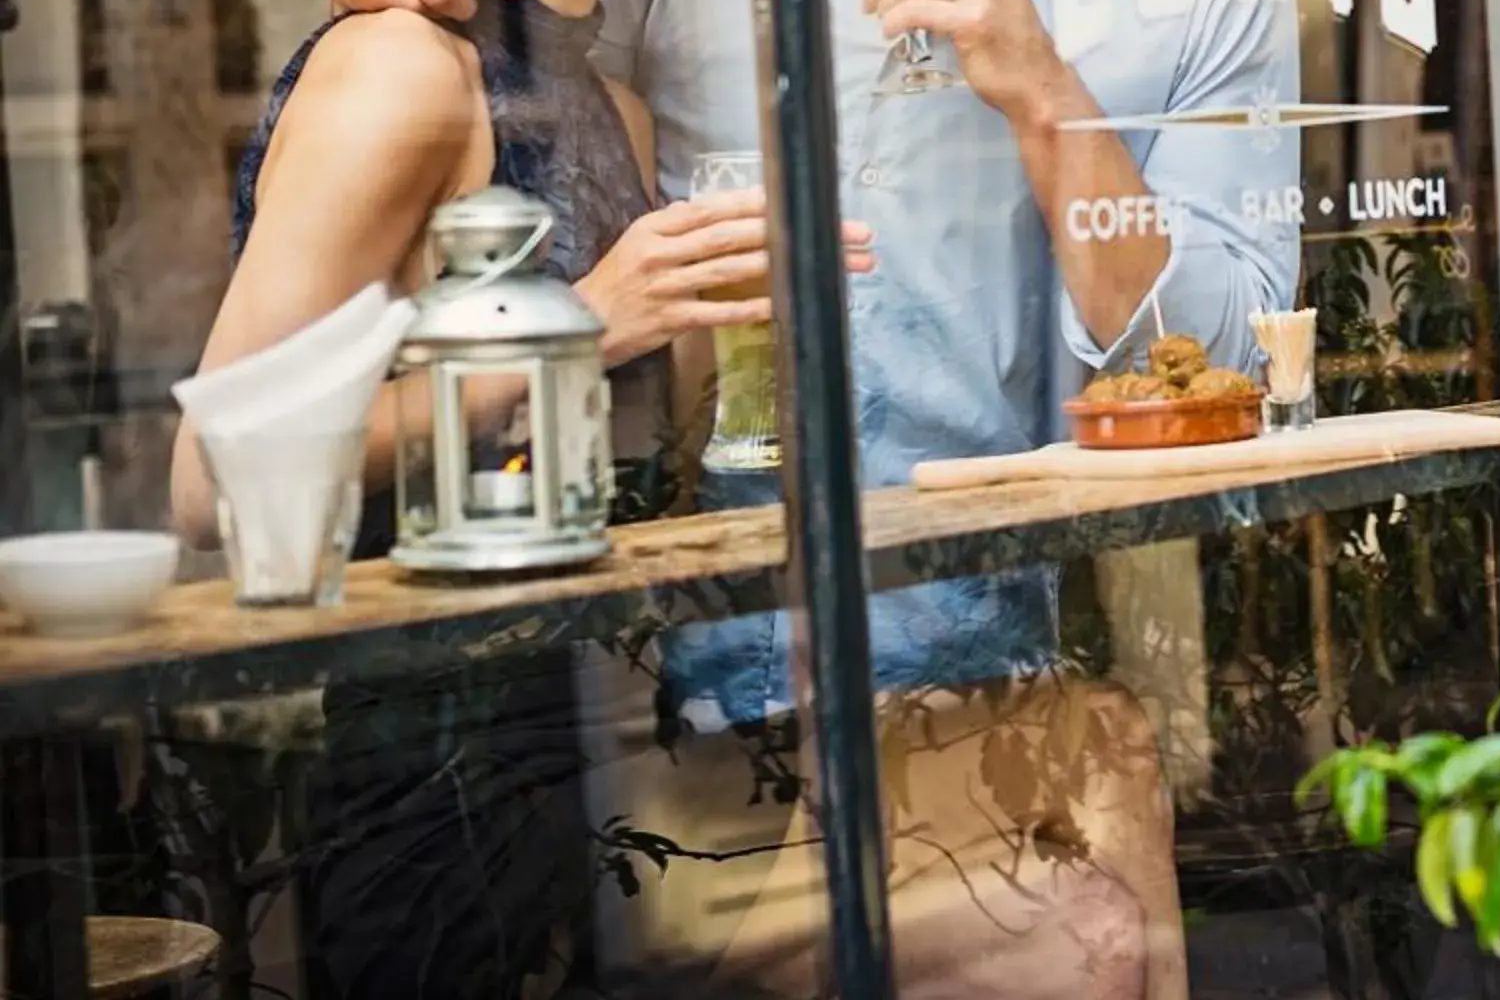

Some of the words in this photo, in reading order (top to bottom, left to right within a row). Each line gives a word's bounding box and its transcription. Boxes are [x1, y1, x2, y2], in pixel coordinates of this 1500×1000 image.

[1066, 195, 1188, 242] COFFE
[1242, 186, 1304, 225] BAR
[1349, 177, 1447, 220] LUNCH
